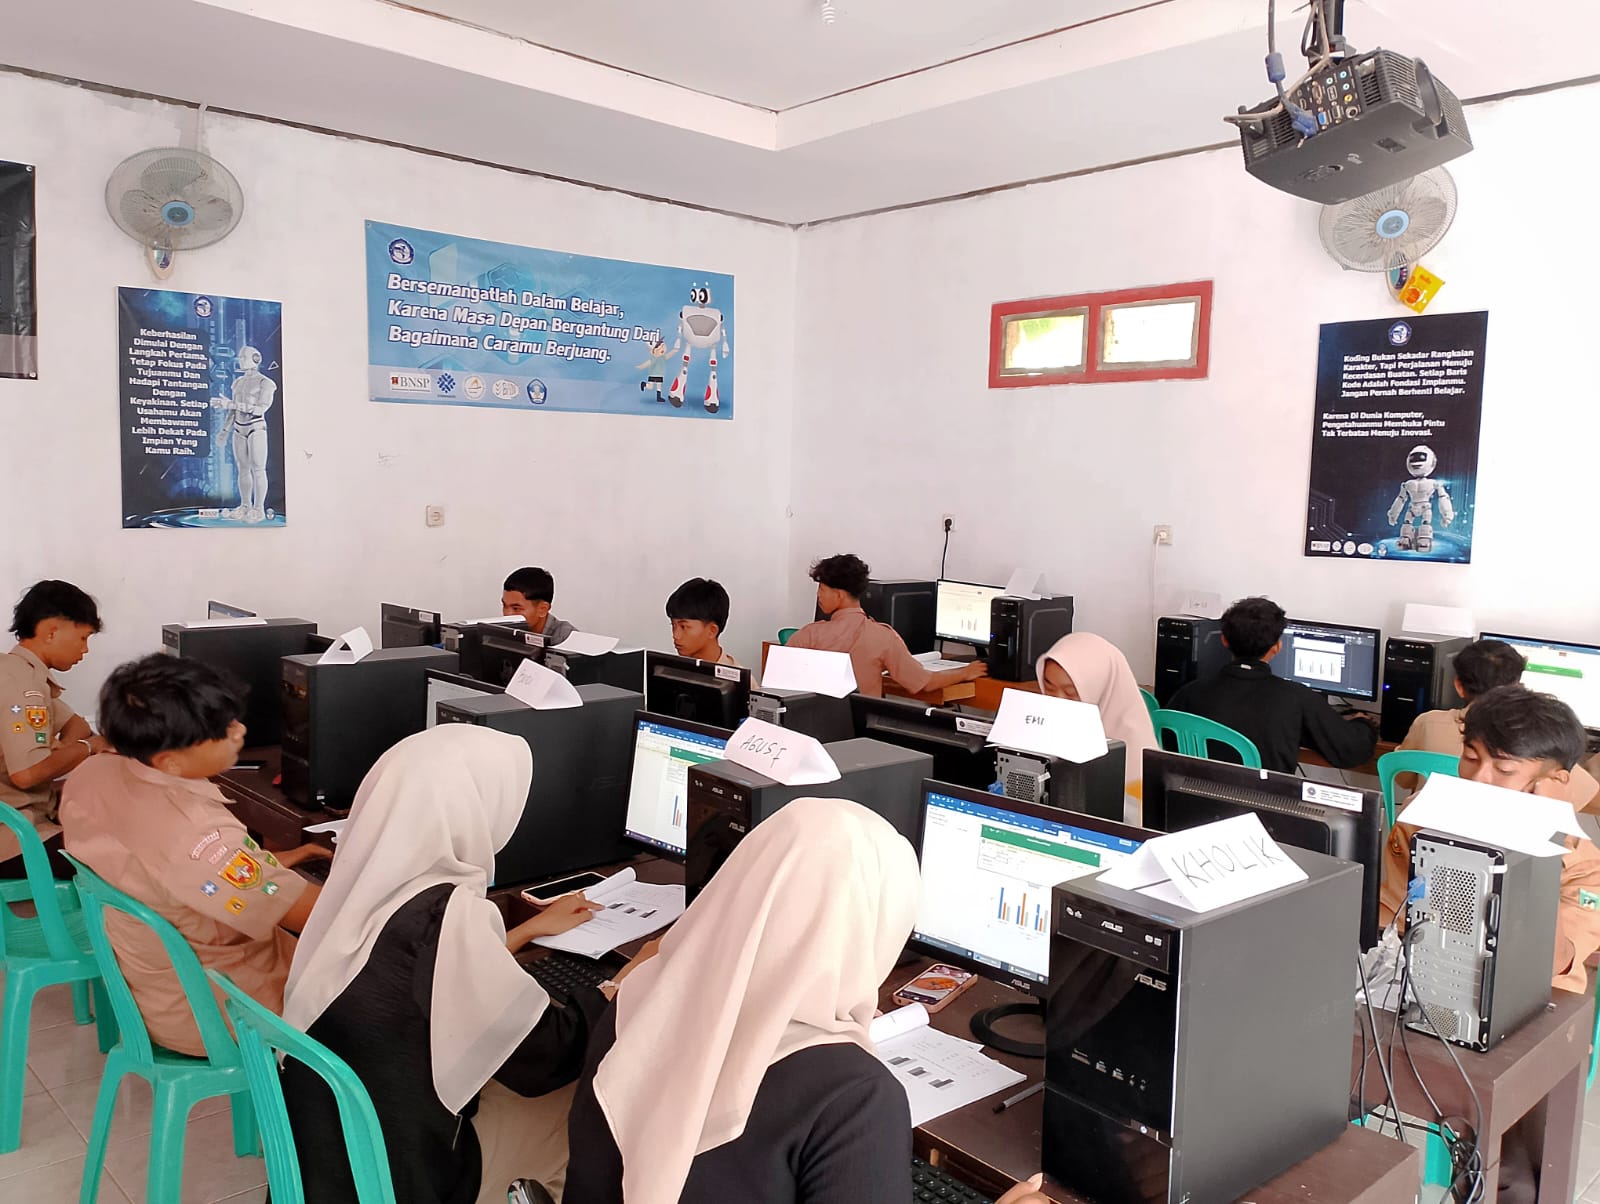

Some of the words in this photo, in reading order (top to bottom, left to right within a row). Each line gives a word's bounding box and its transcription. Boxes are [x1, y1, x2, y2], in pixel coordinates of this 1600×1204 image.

[387, 272, 518, 305] Bersemangatlah
[521, 290, 567, 311] Dalam
[570, 297, 625, 320] Belajar,
[388, 299, 448, 321] Karena
[452, 306, 496, 326] Masa
[500, 311, 547, 332] Depan
[551, 317, 630, 343] Bergantung
[633, 325, 660, 342] Dari
[140, 329, 196, 340] Keberhasilan
[134, 338, 167, 348] Dimulai
[170, 341, 203, 351] Dengan
[388, 325, 479, 348] Bagaimana
[483, 334, 541, 355] Caramu
[545, 340, 611, 364] Berjuang.
[129, 348, 167, 358] Langkah
[169, 351, 207, 360] Pertama.
[1344, 354, 1370, 363] Koding
[1372, 353, 1396, 361] Bukan
[1398, 352, 1429, 360] Sekadar
[1431, 350, 1474, 358] Rangkaian
[130, 358, 156, 367] Tetap
[158, 359, 183, 368] Fokus
[1343, 363, 1378, 371] Karakter,
[1380, 362, 1397, 370] Tapi
[1398, 361, 1441, 369] Perjalanan
[1442, 359, 1472, 367] Menuju
[137, 368, 181, 378] Tujuanmu
[183, 371, 201, 379] Dan
[1419, 369, 1445, 378] Setiap
[1447, 368, 1467, 376] Baris
[129, 378, 160, 387] Hadapi
[162, 380, 208, 390] Tantangan
[400, 376, 430, 388] BNSP
[1342, 381, 1361, 389] Kode
[1363, 380, 1388, 388] Adalah
[1422, 378, 1466, 386] Impianmu.
[153, 388, 186, 398] Dengan
[1341, 390, 1368, 398] Jangan
[1434, 387, 1465, 395] Belajar.
[130, 397, 178, 407] Keyakinan.
[181, 400, 208, 409] Setiap
[137, 407, 178, 416] Usahamu
[180, 408, 202, 417] Akan
[141, 417, 198, 427] Membawamu
[1322, 421, 1382, 429] Pengetahuanmu
[132, 427, 156, 435] Lebih
[186, 429, 207, 437] Pada
[1371, 429, 1399, 437] Menuju
[142, 437, 173, 445] Impian
[176, 438, 198, 447] Yang
[145, 447, 171, 455] Kamu
[728, 821, 745, 833] ASUS
[1171, 836, 1284, 889] KHOLIK
[1101, 920, 1124, 933] ASUS
[1011, 979, 1030, 990] ASUS
[1134, 973, 1167, 991] ASUS
